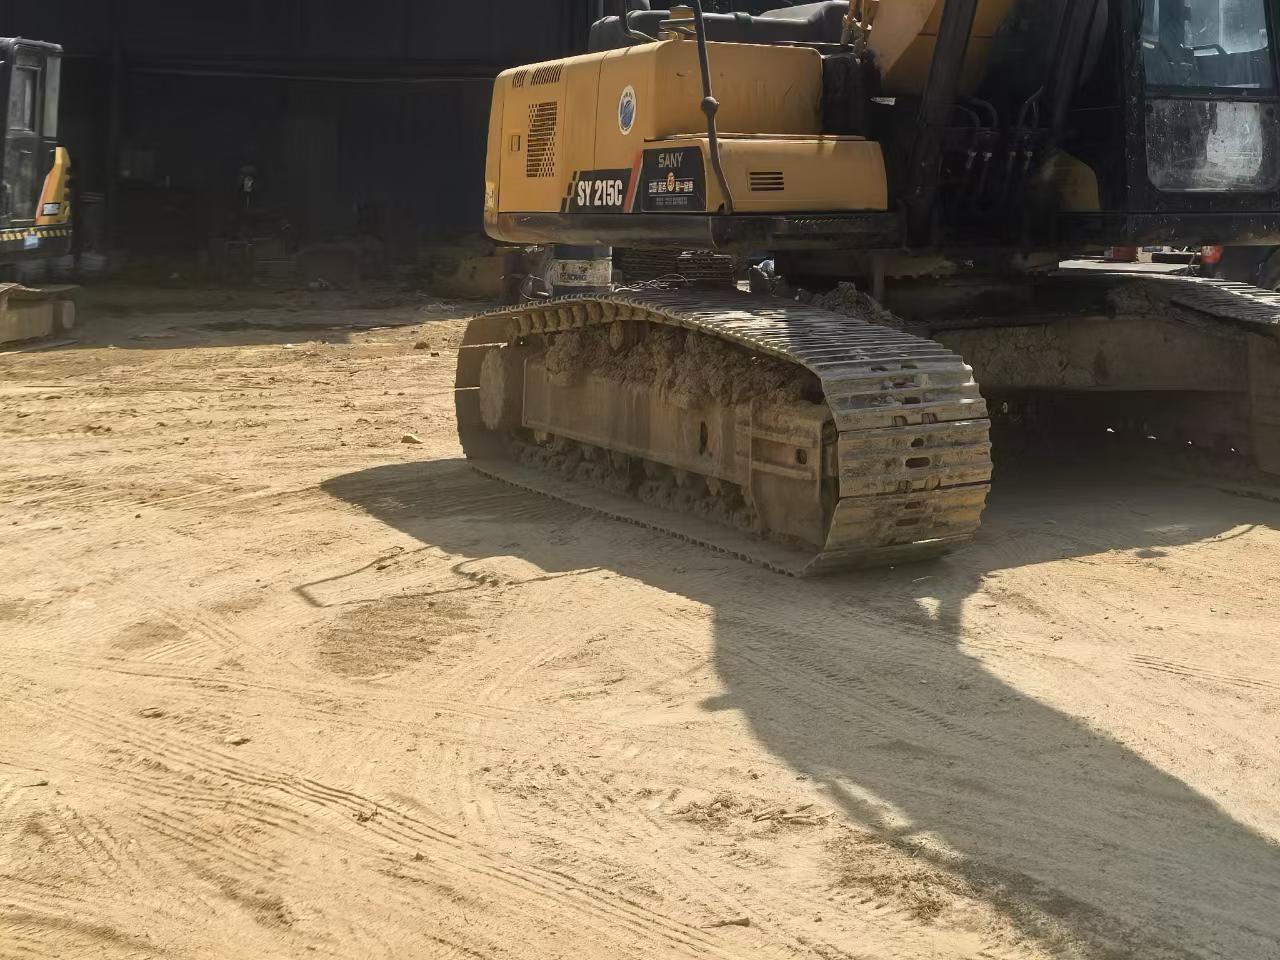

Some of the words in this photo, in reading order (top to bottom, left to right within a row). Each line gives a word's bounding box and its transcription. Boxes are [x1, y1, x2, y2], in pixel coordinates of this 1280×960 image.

[658, 152, 683, 168] SANY
[577, 180, 592, 206] SY
[594, 179, 623, 206] 215C
